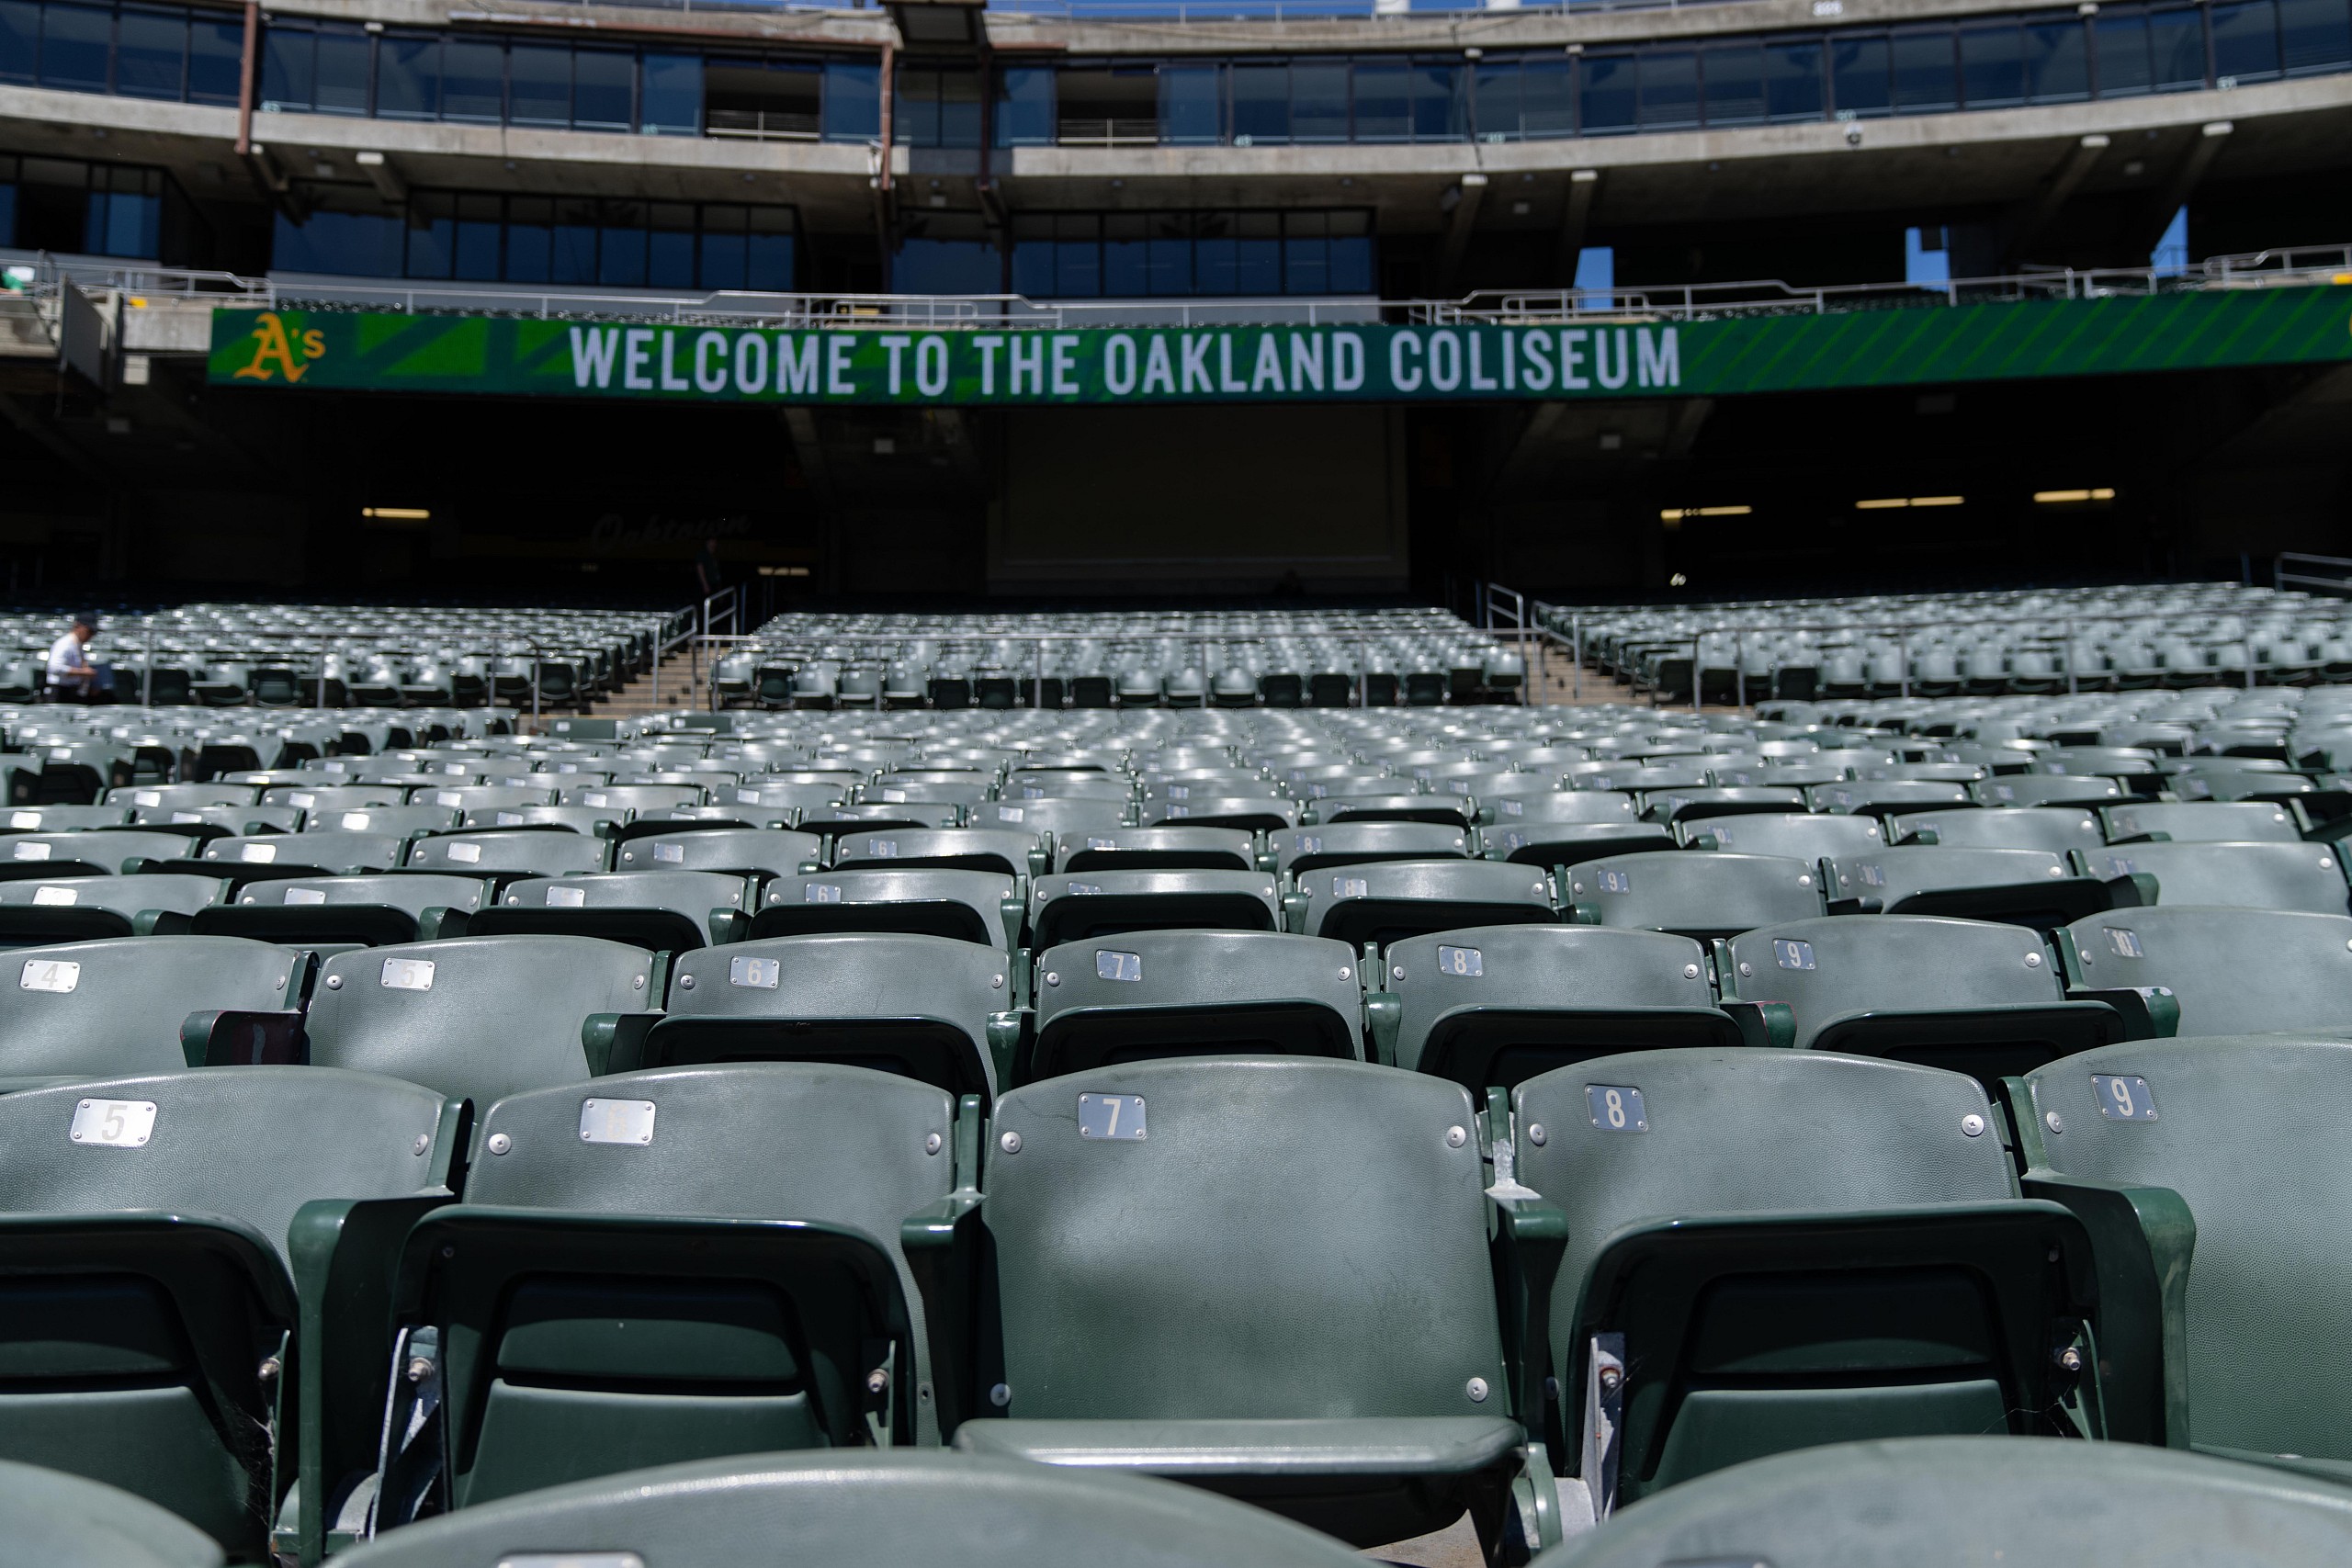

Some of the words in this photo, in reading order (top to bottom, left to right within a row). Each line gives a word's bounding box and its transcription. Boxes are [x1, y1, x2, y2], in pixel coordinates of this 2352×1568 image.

[232, 311, 326, 383] A's
[570, 325, 857, 395] WELCOME
[880, 335, 949, 396] TO
[972, 335, 1080, 395] THE
[1104, 332, 1365, 395] OAKLAND
[1390, 327, 1681, 392] COLISEUM
[878, 840, 888, 856] 6
[1304, 837, 1313, 852] 8
[818, 886, 828, 902] 6
[1344, 879, 1354, 897] 8
[1607, 873, 1618, 892] 9
[1787, 942, 1802, 967] 9
[2111, 930, 2134, 956] 10
[747, 960, 762, 985] 6
[1112, 954, 1125, 979] 7
[1453, 949, 1467, 974] 8
[40, 964, 59, 988] 4
[400, 963, 416, 987] 5
[1605, 1089, 1626, 1129] 8
[2110, 1077, 2134, 1117] 9
[101, 1104, 128, 1142] 5
[605, 1101, 628, 1141] 6
[1102, 1098, 1122, 1136] 7
